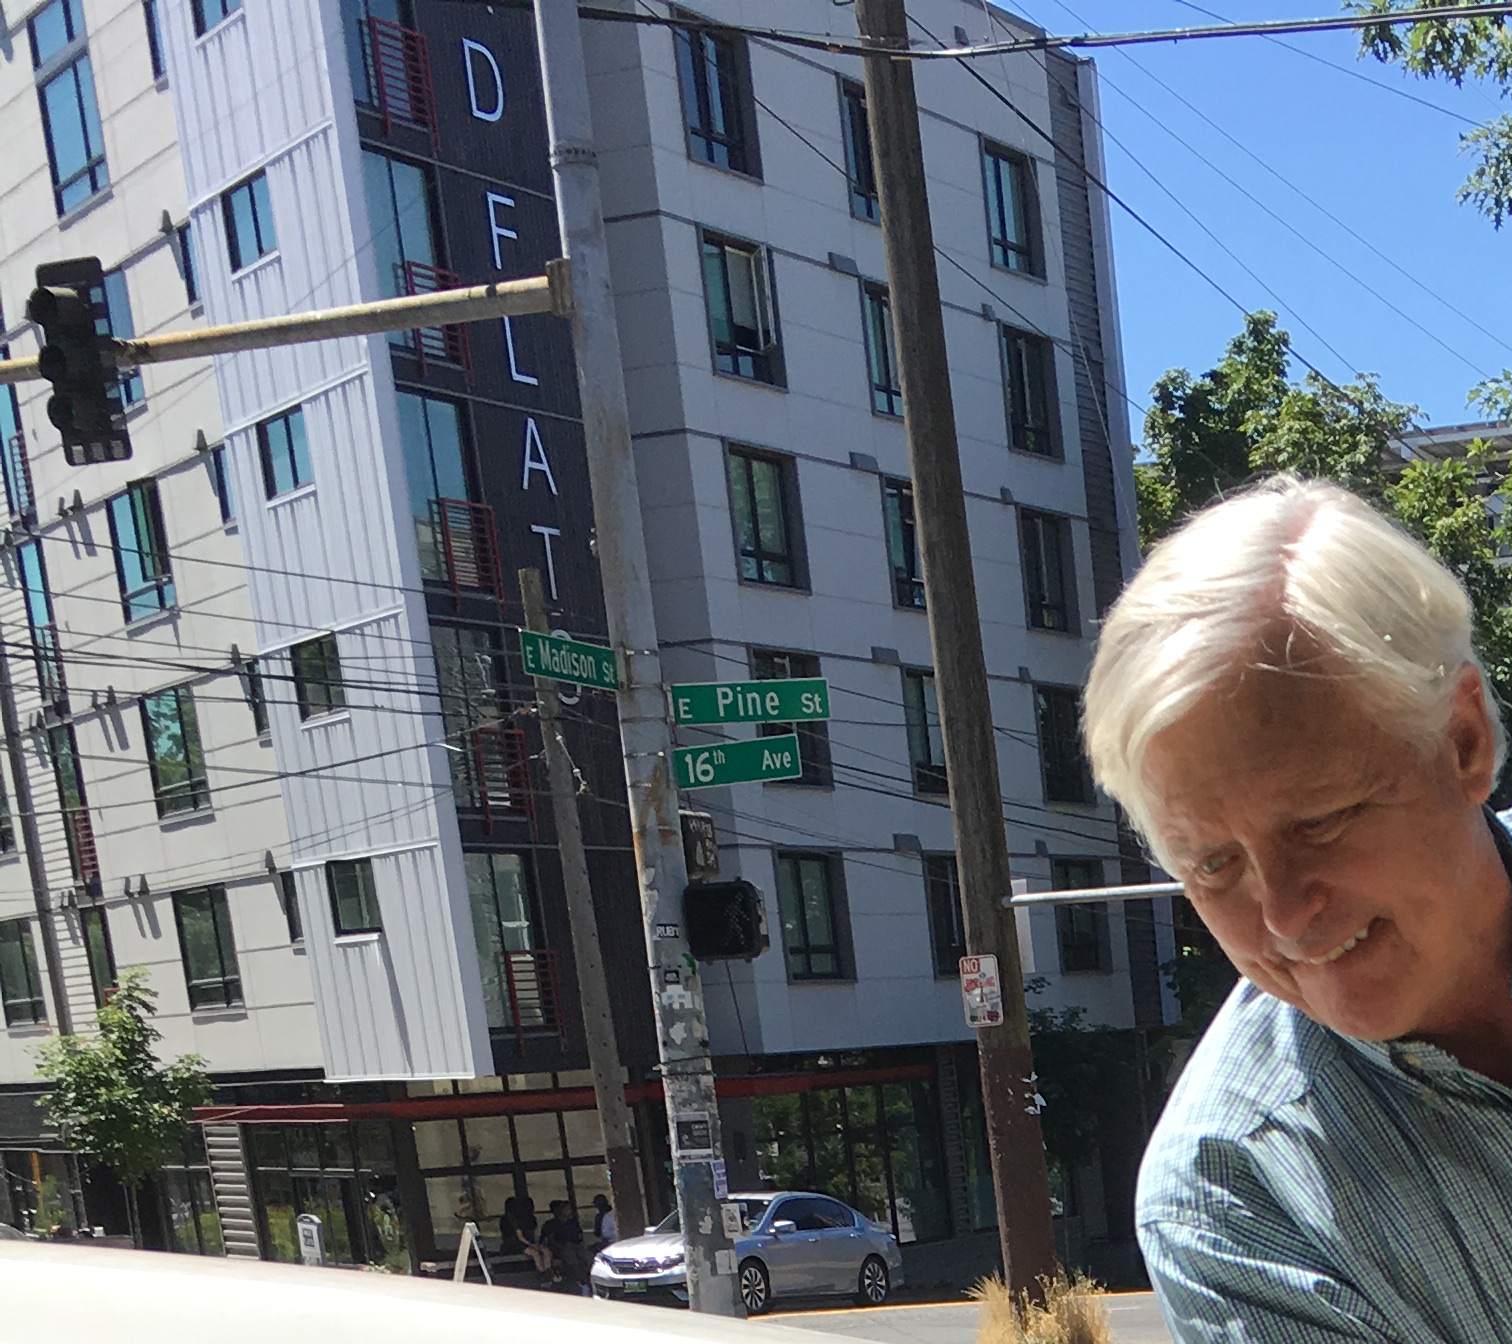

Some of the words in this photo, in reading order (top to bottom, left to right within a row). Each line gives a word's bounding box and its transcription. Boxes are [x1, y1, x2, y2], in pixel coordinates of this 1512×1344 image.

[526, 646, 535, 668] E
[538, 639, 598, 680] Madison
[602, 660, 615, 685] St
[679, 699, 693, 719] E
[716, 687, 780, 718] Pine
[801, 692, 823, 714] St
[684, 750, 726, 784] 16th
[761, 749, 792, 771] Ave
[963, 959, 978, 973] NO
